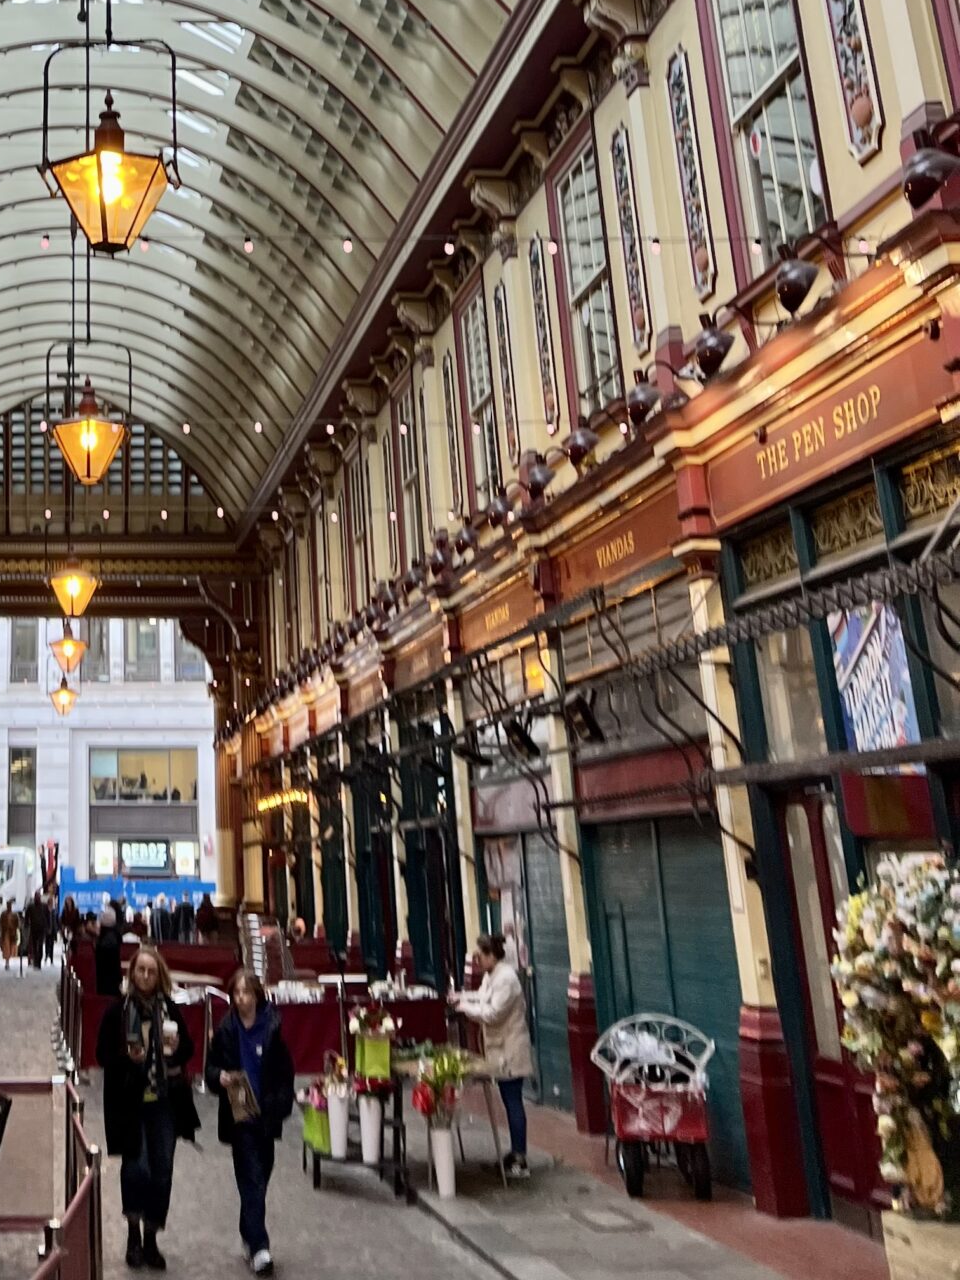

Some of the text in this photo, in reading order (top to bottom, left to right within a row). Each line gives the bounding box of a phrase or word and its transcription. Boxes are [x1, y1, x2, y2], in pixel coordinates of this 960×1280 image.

[756, 384, 881, 480] THE PEN SHOP
[596, 530, 635, 569] VIANDAS
